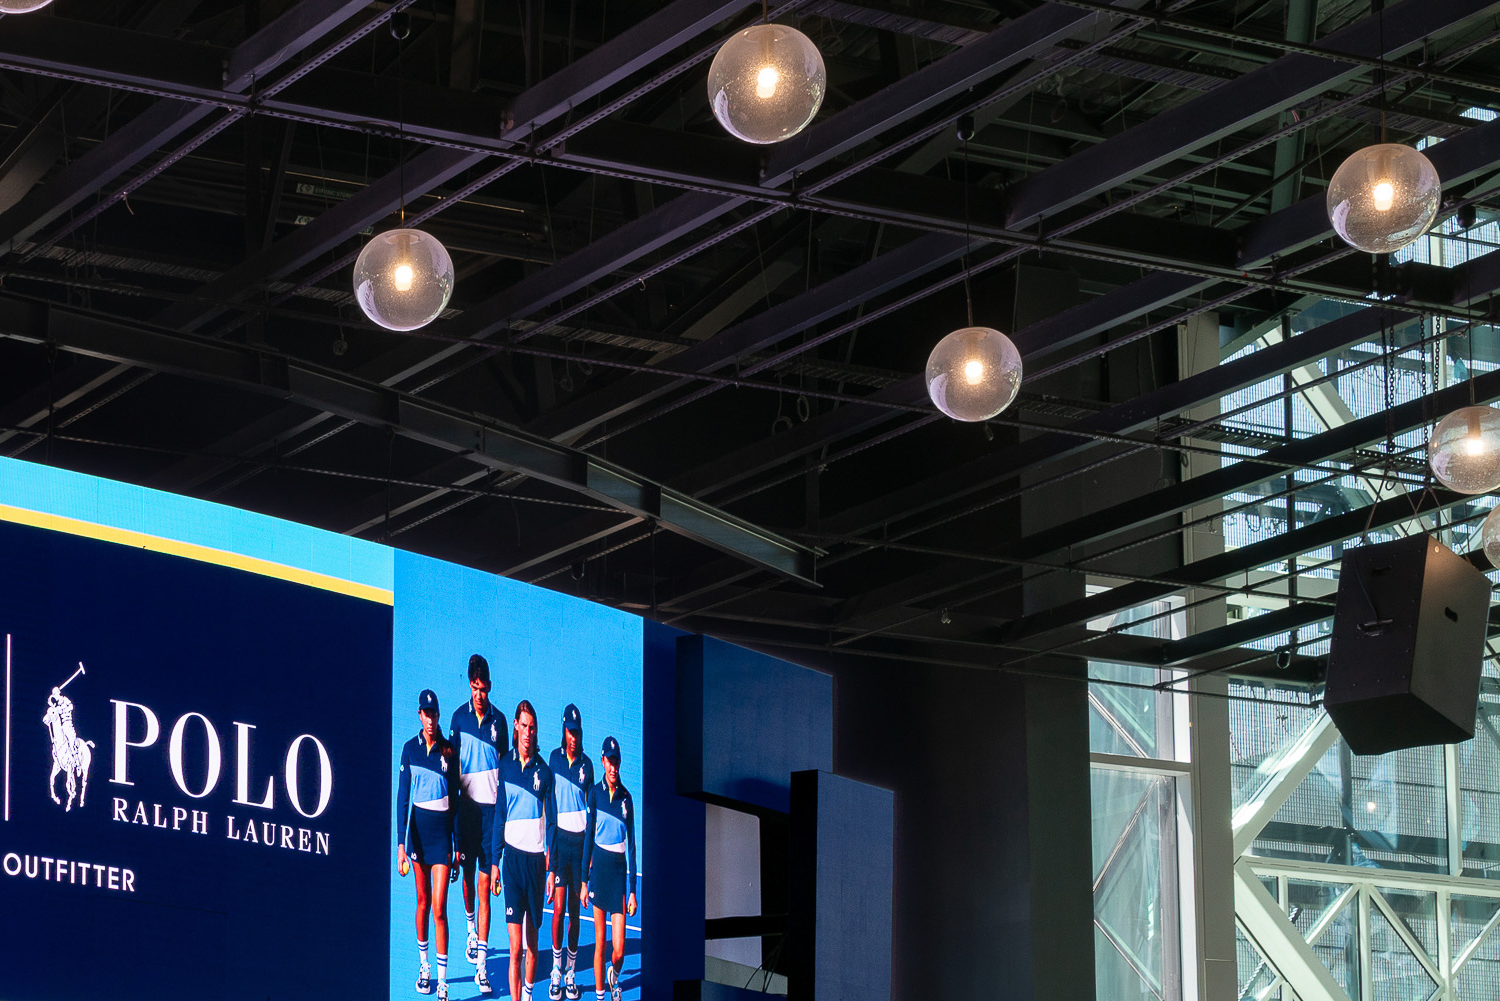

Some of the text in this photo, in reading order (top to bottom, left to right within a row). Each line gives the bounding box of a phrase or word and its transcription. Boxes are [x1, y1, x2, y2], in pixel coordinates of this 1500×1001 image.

[109, 698, 333, 819] POLO
[112, 797, 330, 856] RALPH LAUREN
[3, 852, 136, 893] OUTFITTER
